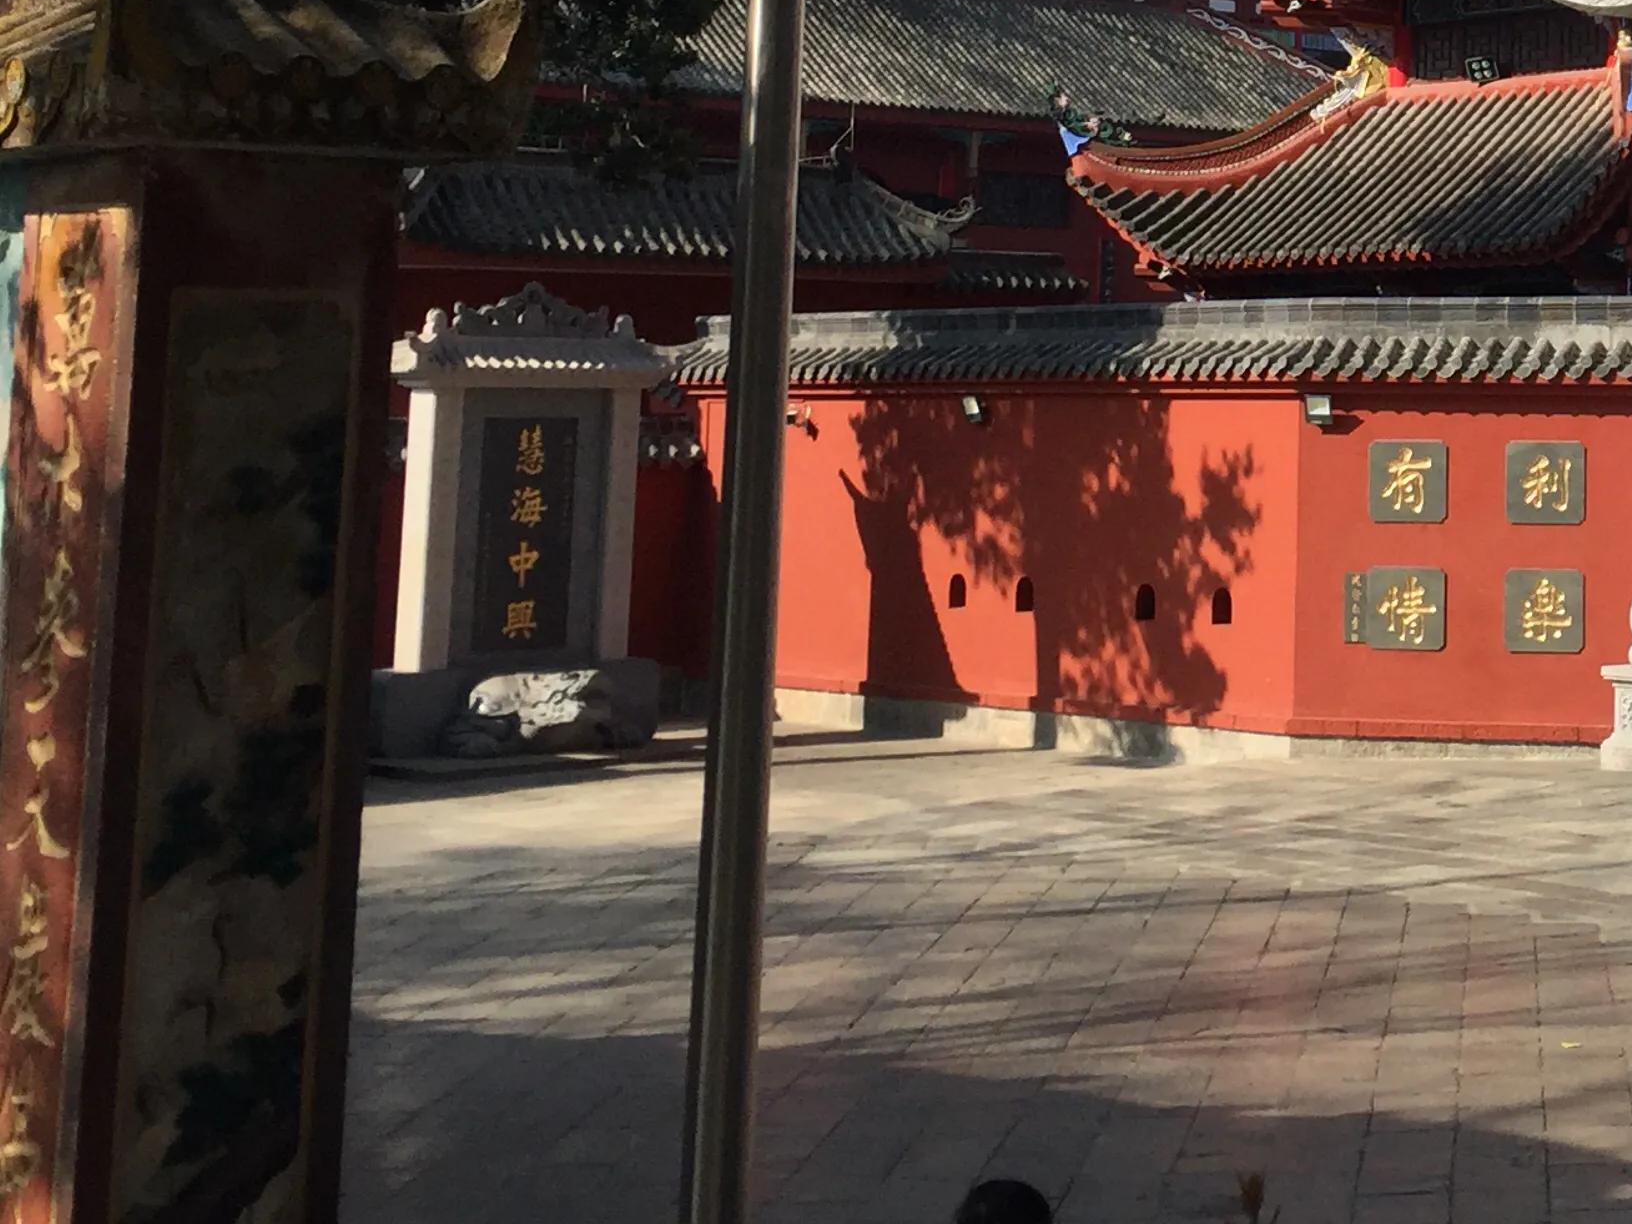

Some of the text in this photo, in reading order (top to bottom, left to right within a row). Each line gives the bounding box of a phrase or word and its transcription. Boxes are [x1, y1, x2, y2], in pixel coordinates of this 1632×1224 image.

[1380, 446, 1432, 514] 有
[1519, 453, 1572, 513] 利
[502, 424, 548, 640] 慧海中興
[1376, 575, 1438, 645] 情
